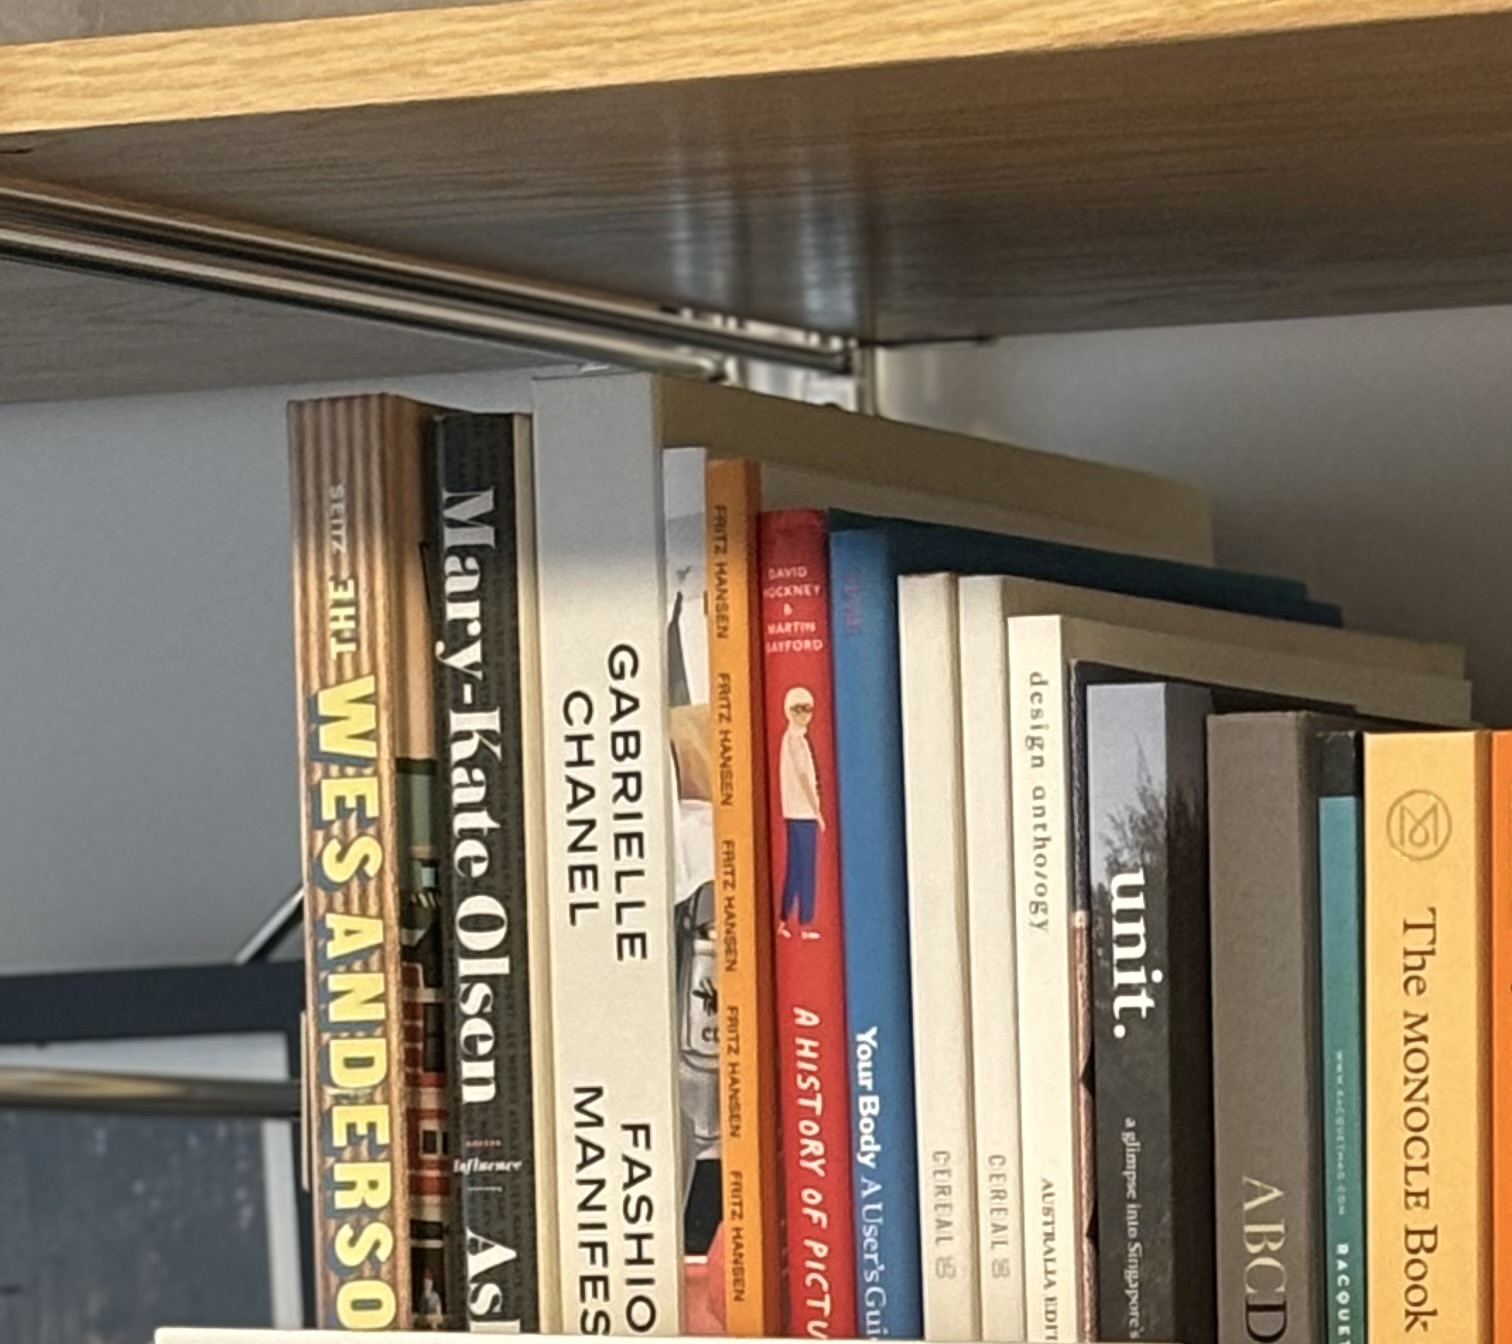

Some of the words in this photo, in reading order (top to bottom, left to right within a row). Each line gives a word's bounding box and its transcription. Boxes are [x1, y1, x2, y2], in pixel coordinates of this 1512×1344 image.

[330, 483, 347, 553] SEITZ
[714, 505, 728, 556] FRITZ
[715, 564, 730, 640] HANSEN
[768, 566, 808, 580] DAVID
[328, 578, 357, 660] THE
[768, 621, 816, 635] MARTIN
[436, 487, 502, 878] Mary-Kate
[718, 672, 731, 723] FRITZ
[1024, 671, 1049, 769] design
[314, 674, 384, 886] WES
[607, 643, 649, 962] GABRIELLE
[719, 729, 735, 808] HANSEN
[563, 690, 600, 927] CHANEL
[722, 839, 736, 890] FRITZ
[1028, 785, 1052, 932] anthology
[725, 897, 739, 973] HANSEN
[1110, 867, 1163, 1040] unit.
[1403, 907, 1436, 997] The
[455, 895, 510, 1104] Olsen
[727, 1005, 740, 1056] FRITZ
[793, 1007, 820, 1027] A
[855, 1026, 879, 1091] Your
[322, 912, 397, 1330] ANDERSO
[728, 1063, 742, 1139] HANSEN
[794, 1038, 826, 1180] HISTORY
[856, 1096, 882, 1169] Body
[1124, 1117, 1137, 1128] a
[1403, 1011, 1431, 1211] MONOCLE
[730, 1171, 744, 1222] FRITZ
[861, 1178, 878, 1199] A
[932, 1150, 953, 1246] CEREAL
[988, 1154, 1009, 1250] CEREAL
[1121, 1130, 1142, 1201] glimpse
[573, 1085, 611, 1336] MANIFES
[620, 1122, 657, 1333] FASHIO
[801, 1188, 828, 1229] OF
[862, 1205, 887, 1283] User's
[1040, 1176, 1058, 1292] AUSTRALIA
[1126, 1204, 1141, 1238] into
[732, 1226, 746, 1303] HANSEN
[1404, 1224, 1439, 1333] Book
[864, 1284, 889, 1341] Gui
